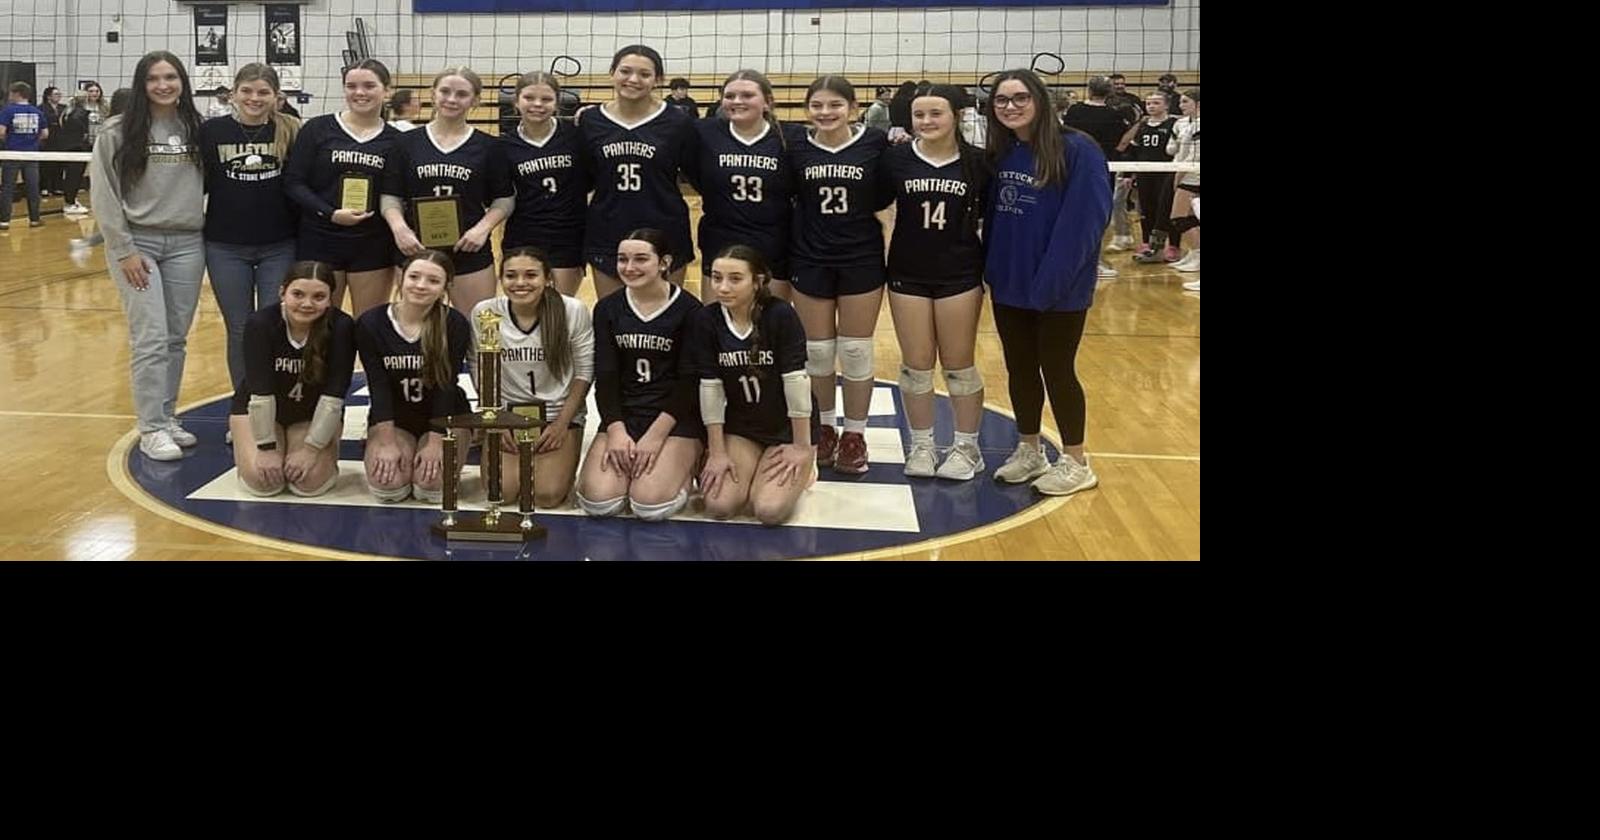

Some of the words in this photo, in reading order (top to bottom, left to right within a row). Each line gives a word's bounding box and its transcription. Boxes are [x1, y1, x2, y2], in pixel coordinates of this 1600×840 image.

[602, 141, 656, 159] PANTHERS
[1142, 135, 1159, 147] 20
[331, 150, 386, 169] PANTHERS
[517, 155, 572, 176] PANTHERS
[719, 154, 778, 170] PANTHERS
[416, 163, 472, 181] PANTHERS
[617, 163, 641, 191] 35
[805, 164, 864, 180] PANTHERS
[432, 185, 454, 197] 17
[730, 174, 763, 202] 33
[904, 178, 967, 196] PANTHERS
[819, 186, 848, 214] 23
[920, 200, 947, 230] 14
[615, 333, 674, 352] PANTHERS
[383, 354, 424, 370] PANTH
[501, 347, 545, 362] PANTHE
[636, 358, 651, 383] 9
[288, 382, 304, 402] 4
[400, 377, 424, 403] 13
[526, 370, 536, 395] 1
[738, 375, 761, 403] 11
